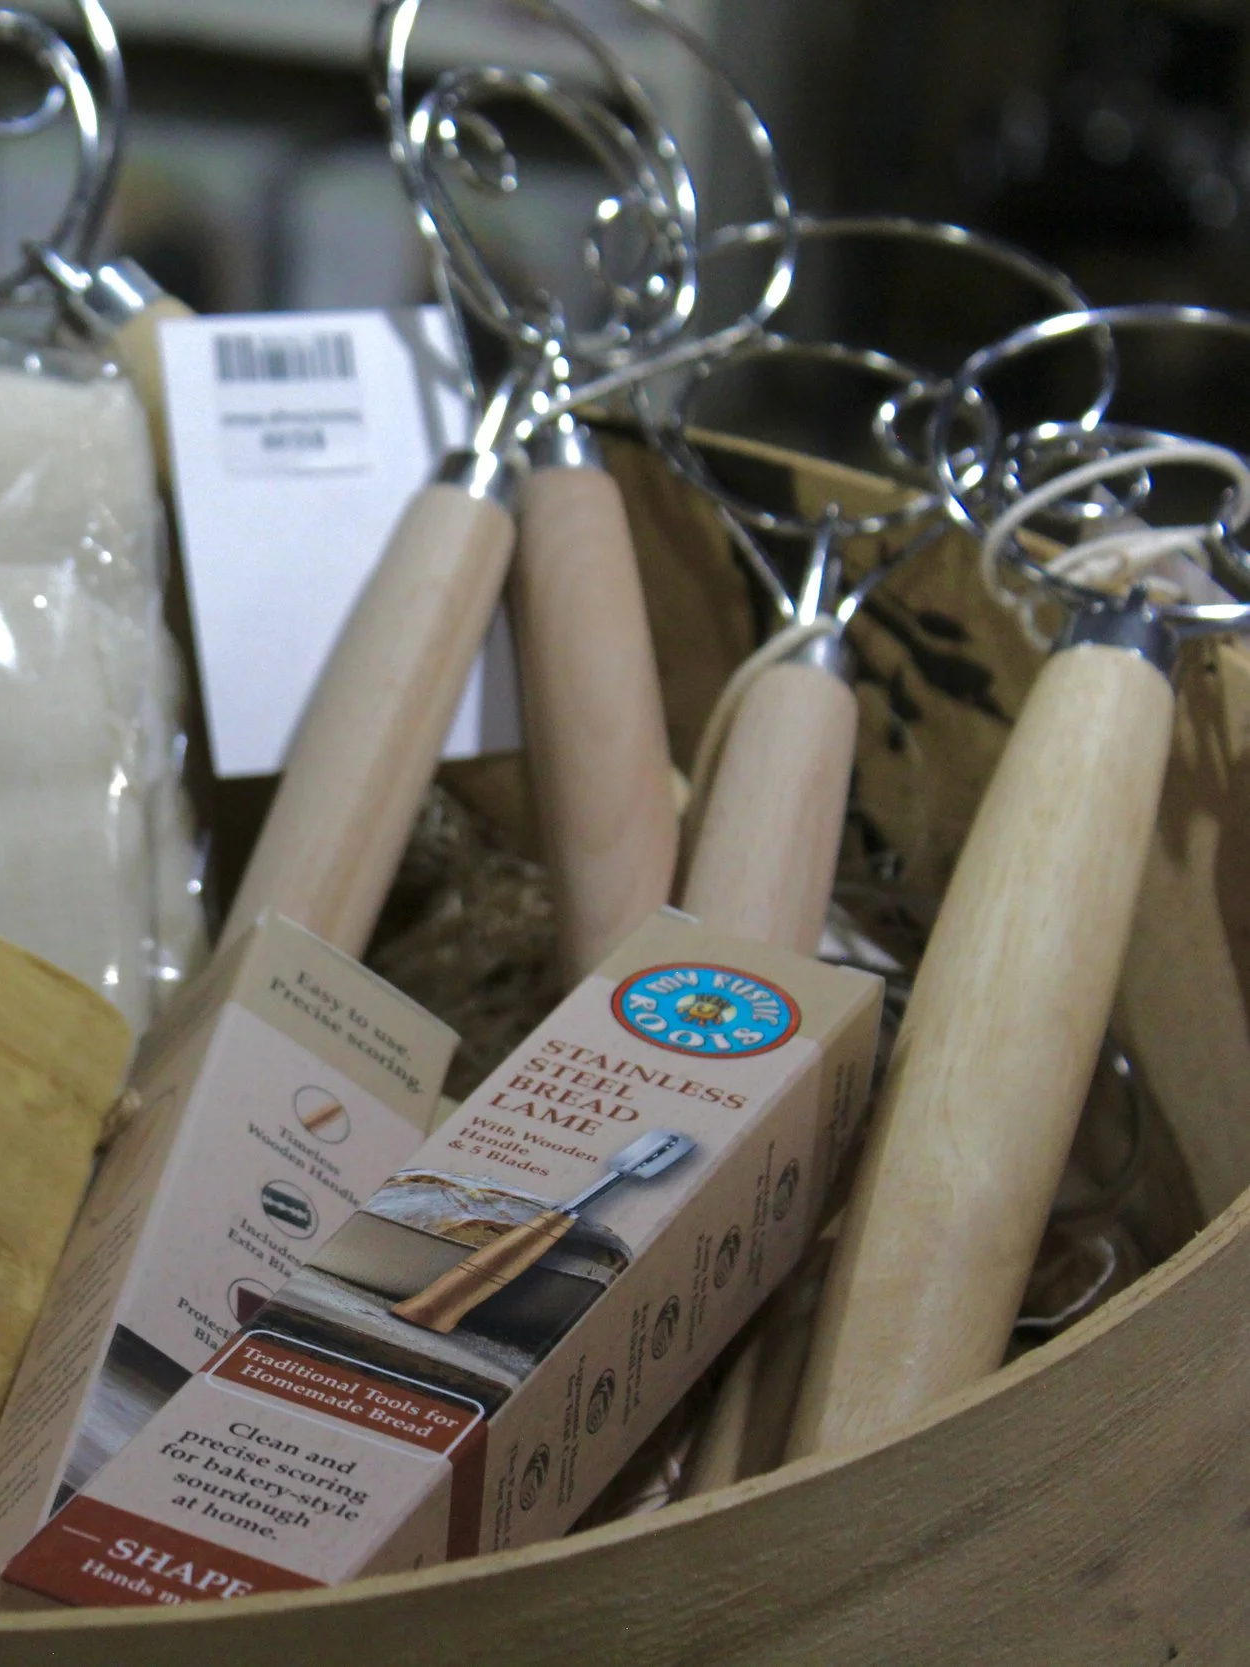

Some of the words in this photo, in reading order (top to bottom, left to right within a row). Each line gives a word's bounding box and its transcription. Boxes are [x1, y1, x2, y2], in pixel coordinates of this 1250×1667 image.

[270, 976, 342, 1034] Precise
[297, 970, 343, 1012] Easy
[348, 1008, 369, 1029] to
[628, 993, 764, 1050] ROOTS
[712, 972, 781, 1027] RUSTIC
[506, 1074, 640, 1123] BREAD
[522, 1056, 634, 1101] STEEL
[541, 1039, 747, 1110] STAINLESS
[470, 1116, 517, 1137] With
[522, 1132, 600, 1165] Wooden
[488, 1092, 604, 1137] LAME
[248, 1122, 307, 1170] Wooden
[278, 1125, 342, 1177] Timeless
[447, 1138, 468, 1151] &
[469, 1144, 482, 1155] 5
[485, 1149, 550, 1177] Blades
[458, 1127, 531, 1157] Handle
[227, 1226, 266, 1259] Extra
[269, 1252, 293, 1279] Bla
[176, 1295, 233, 1340] Protect
[193, 1326, 219, 1351] Bla
[239, 1363, 365, 1415] Homemade
[367, 1407, 435, 1438] Bread
[242, 1346, 359, 1395] Traditional
[364, 1386, 421, 1416] Tools
[424, 1408, 459, 1430] for
[177, 1429, 271, 1469] precise
[274, 1461, 372, 1506] scoring
[229, 1421, 300, 1456] Clean
[305, 1448, 358, 1476] and
[159, 1442, 199, 1467] for
[201, 1456, 361, 1522] bakery-style
[172, 1470, 311, 1529] sourdough
[171, 1493, 197, 1510] at
[201, 1497, 278, 1541] home.
[80, 1557, 156, 1596] Hands
